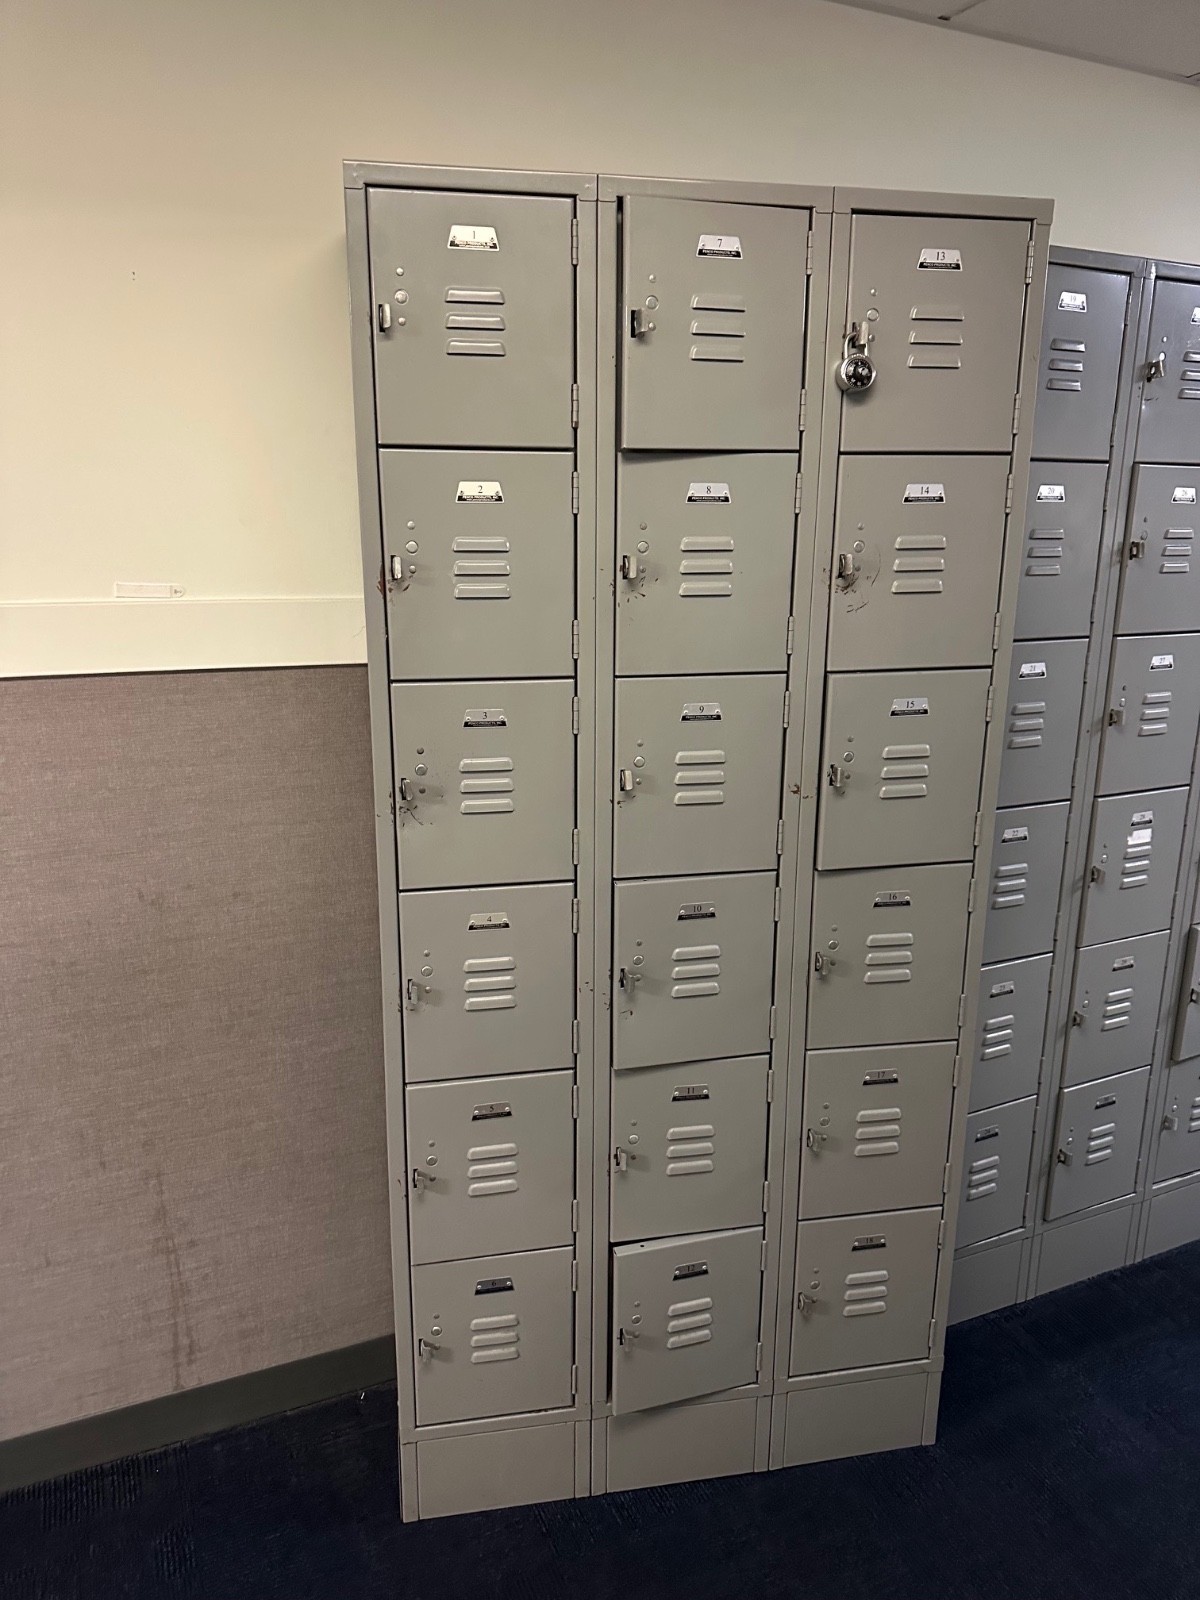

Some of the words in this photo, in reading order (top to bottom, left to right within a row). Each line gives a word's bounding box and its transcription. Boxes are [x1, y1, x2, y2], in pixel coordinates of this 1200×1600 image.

[717, 238, 723, 248] 7
[936, 251, 946, 261] 13
[1070, 295, 1077, 303] 19
[477, 485, 483, 494] 2
[706, 485, 712, 495] 8
[920, 486, 930, 495] 14
[1047, 487, 1055, 495] 20
[906, 700, 915, 709] 15
[699, 705, 705, 714] 9
[482, 711, 488, 720] 3
[693, 905, 702, 913] 10
[687, 1264, 695, 1272] 12
